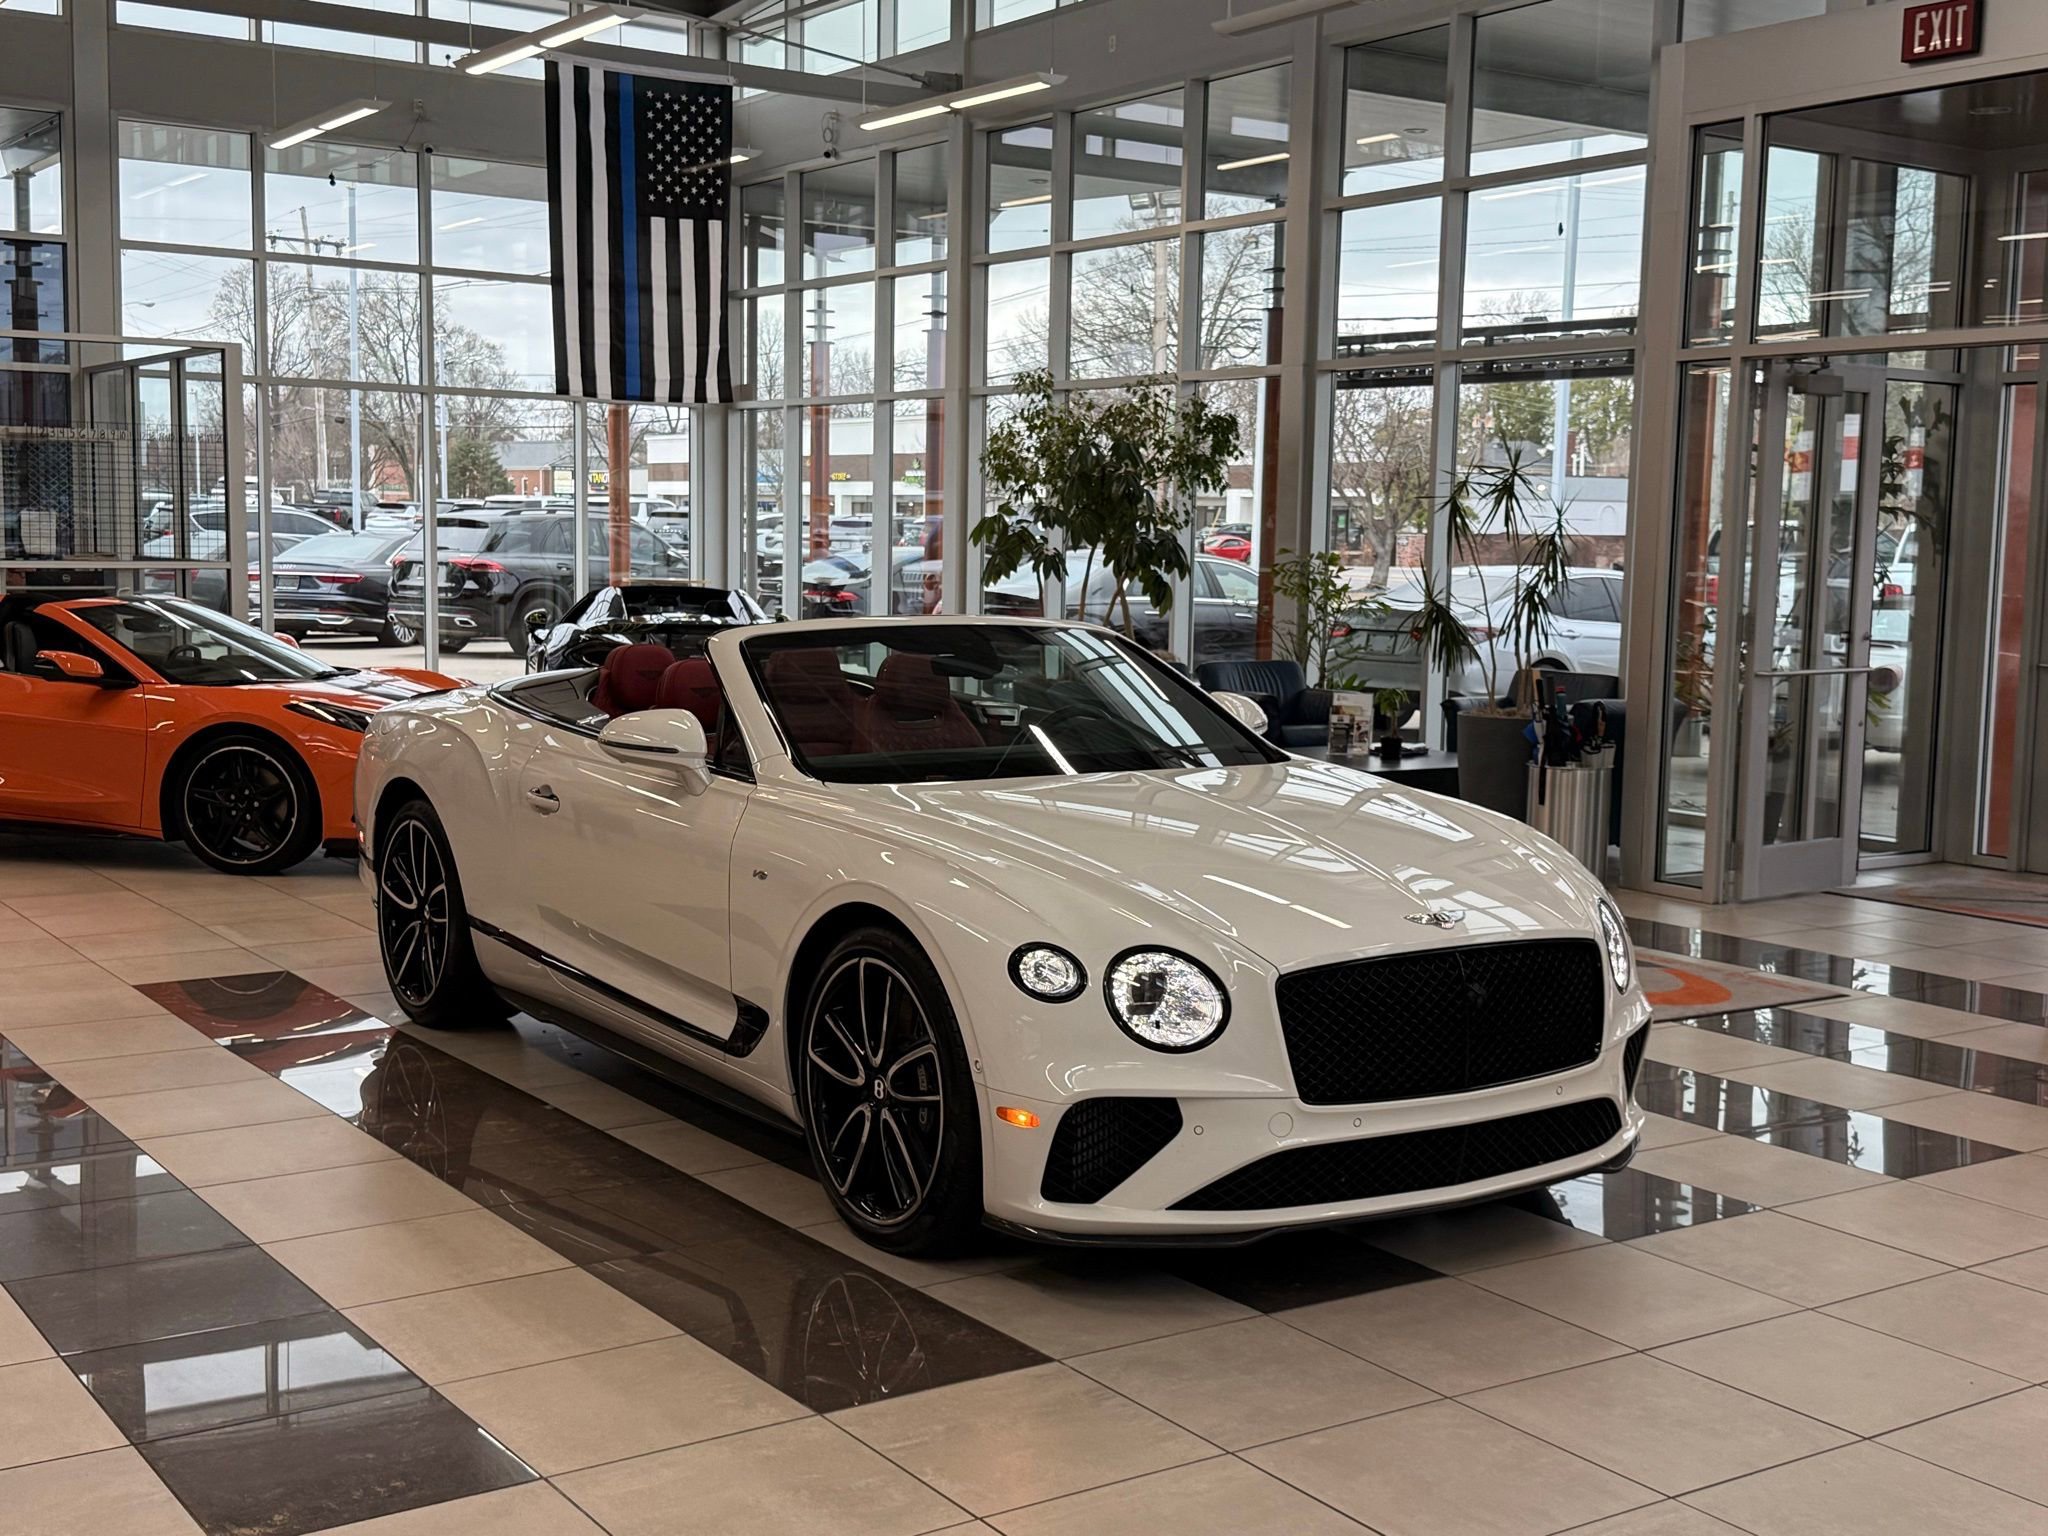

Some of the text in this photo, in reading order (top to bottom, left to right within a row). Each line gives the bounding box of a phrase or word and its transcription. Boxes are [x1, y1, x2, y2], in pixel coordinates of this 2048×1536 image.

[1913, 4, 1968, 53] EXIT
[50, 427, 56, 437] 3
[59, 427, 65, 437] 4
[70, 428, 76, 437] 5
[79, 428, 86, 438] 6
[100, 429, 105, 440] 8
[119, 430, 125, 440] 10
[874, 1079, 884, 1099] B
